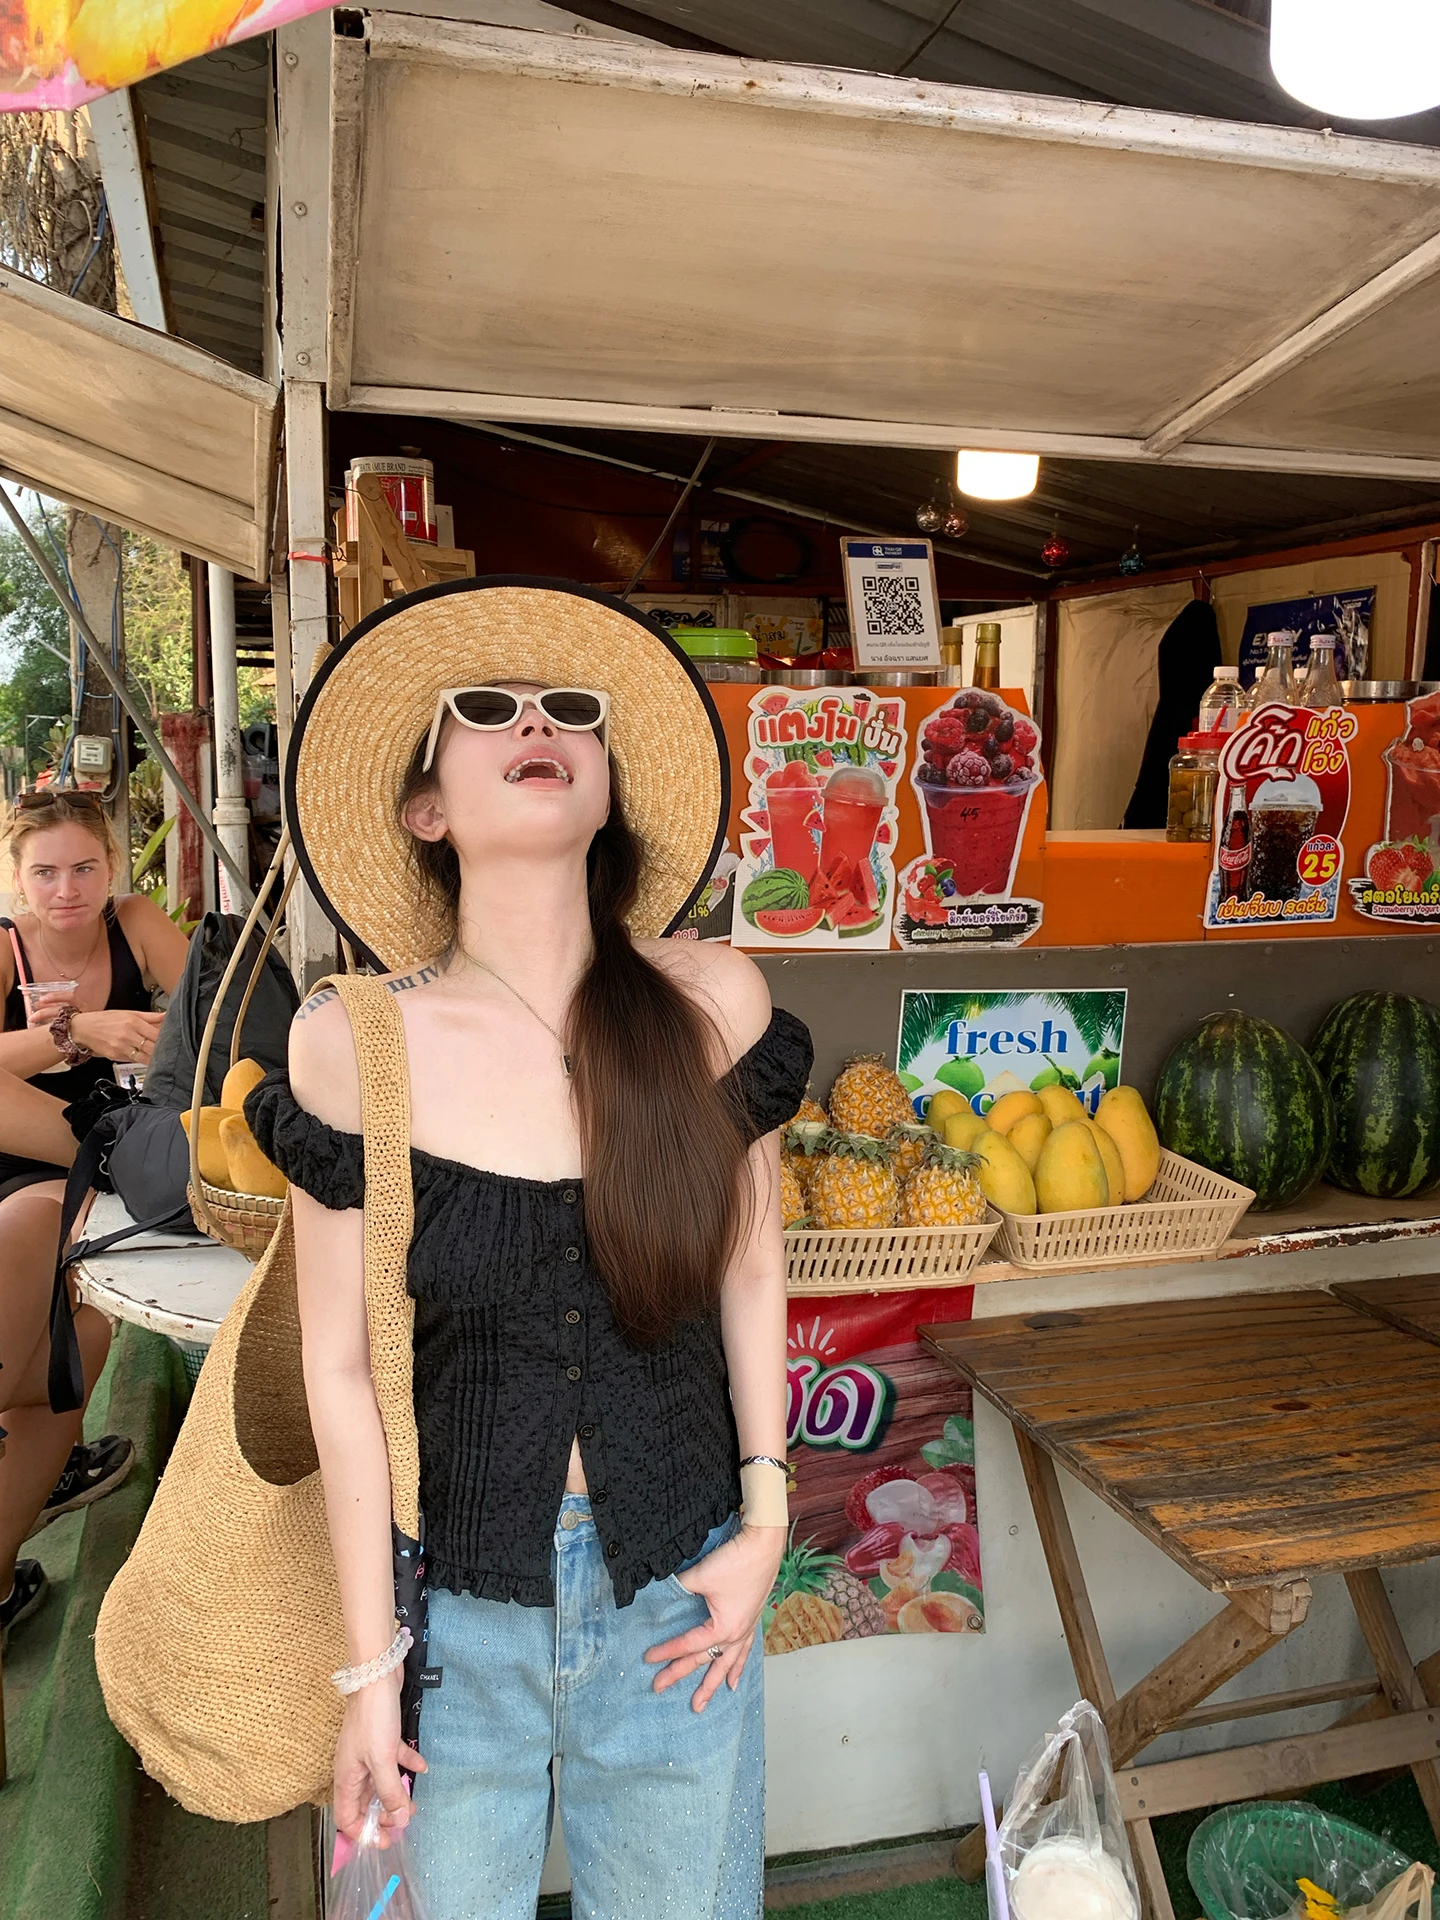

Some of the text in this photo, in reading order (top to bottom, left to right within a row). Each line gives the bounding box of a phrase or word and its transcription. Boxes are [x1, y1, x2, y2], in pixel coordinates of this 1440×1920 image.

[387, 462, 406, 472] BRAND
[757, 698, 899, 755] แตงโม ปั่น
[1307, 710, 1354, 739] แก้ว
[1303, 743, 1345, 774] โอ่ง
[960, 807, 981, 823] 45
[1307, 839, 1335, 852] แก้วละ
[1303, 853, 1336, 879] 25
[1284, 891, 1326, 915] สดชื่น
[1362, 883, 1440, 904] สตอโยเกริ
[1373, 904, 1415, 915] Strawberry
[945, 1019, 1068, 1055] fresh
